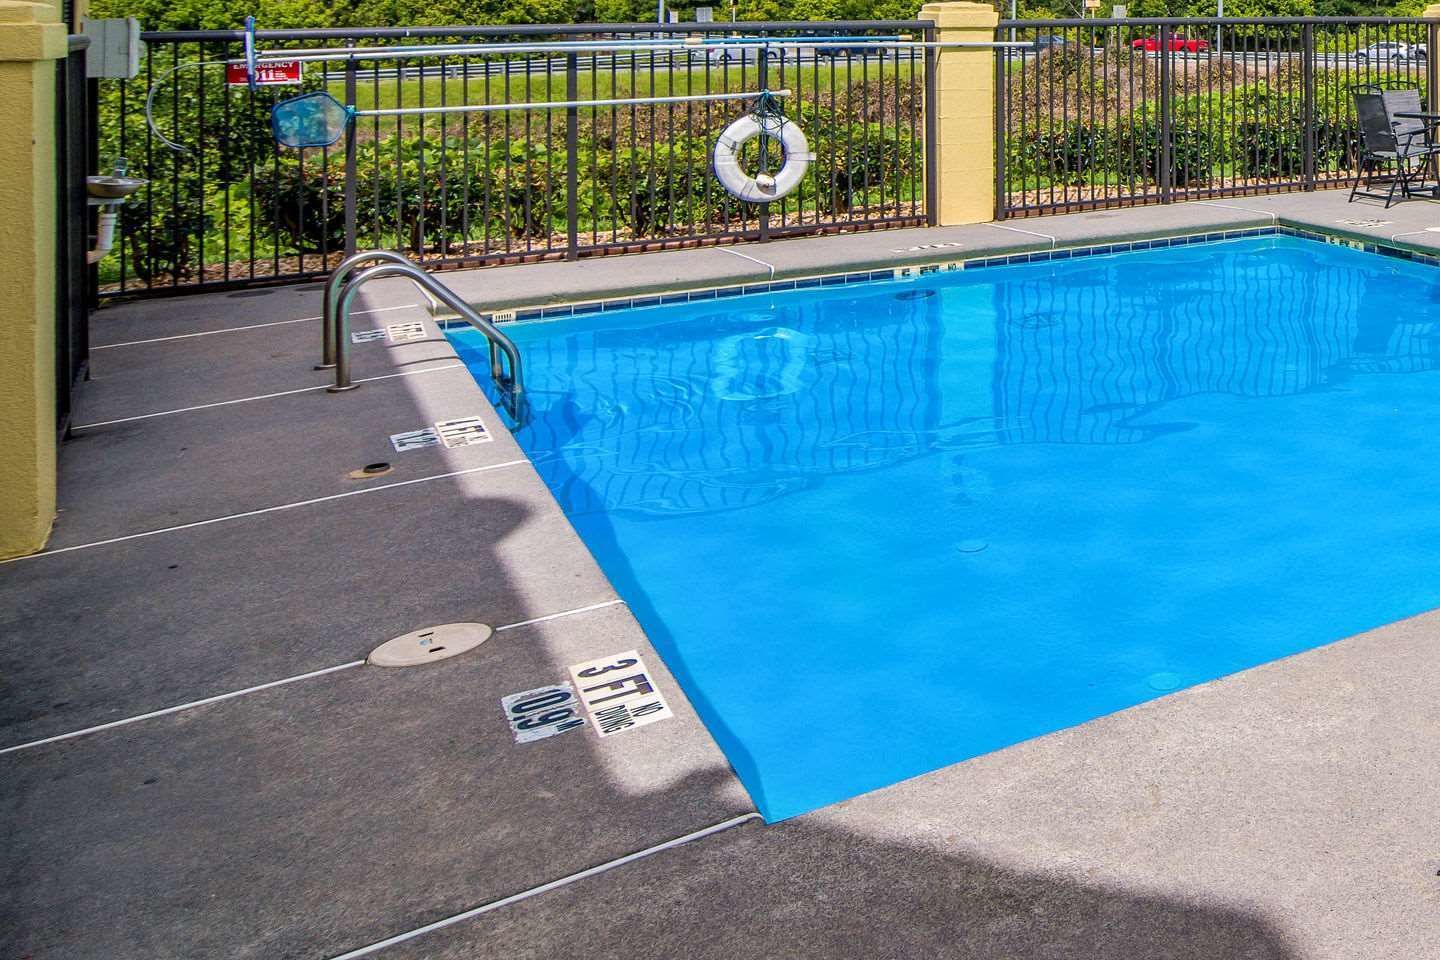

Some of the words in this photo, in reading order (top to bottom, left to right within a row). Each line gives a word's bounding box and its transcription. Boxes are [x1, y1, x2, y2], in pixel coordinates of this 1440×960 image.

[577, 658, 638, 678] 3
[583, 673, 654, 706] FT
[594, 704, 636, 734] DIVING
[630, 701, 664, 718] NO
